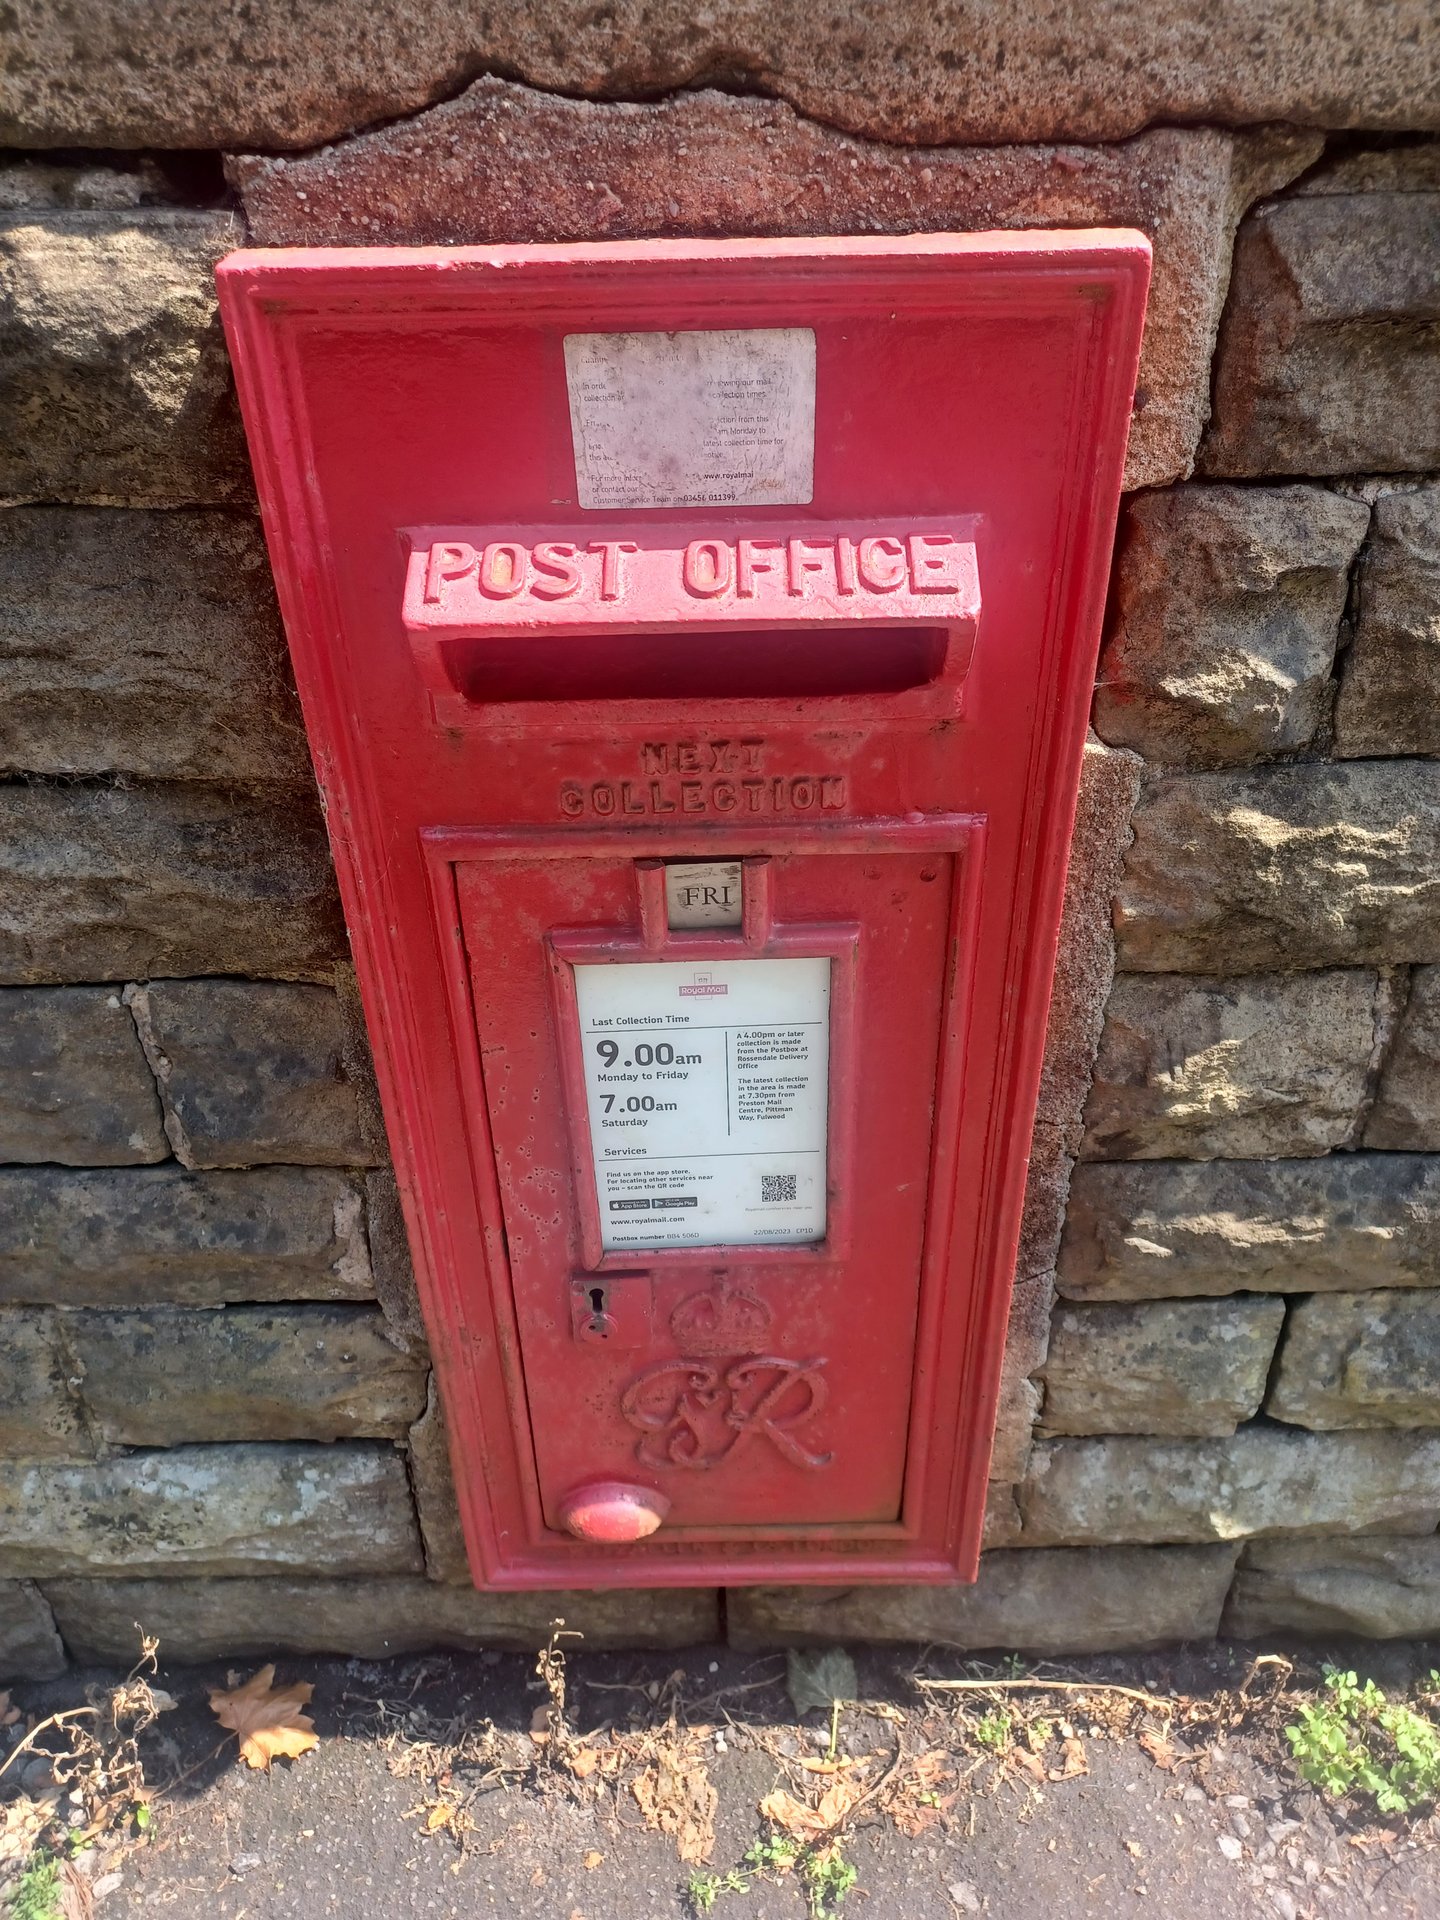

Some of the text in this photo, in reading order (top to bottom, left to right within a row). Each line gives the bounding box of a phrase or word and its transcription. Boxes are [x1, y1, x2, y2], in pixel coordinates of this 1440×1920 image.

[730, 427, 757, 435] Monday
[652, 495, 671, 503] Team
[423, 533, 961, 604] POST OFFICE
[640, 738, 768, 775] NEXT
[560, 776, 846, 816] COLLECTION
[684, 886, 731, 906] FRI
[707, 985, 726, 993] Mail
[592, 1015, 690, 1026] Last Collection Time
[743, 1031, 776, 1039] 4.00pm
[596, 1040, 702, 1068] 9.00am
[597, 1071, 689, 1082] Monday to Friday
[747, 1092, 776, 1100] 7.30pm
[600, 1094, 677, 1113] 7.00am
[602, 1119, 648, 1127] Saturday
[604, 1148, 647, 1156] Services
[610, 1216, 685, 1225] www.royalmail.com
